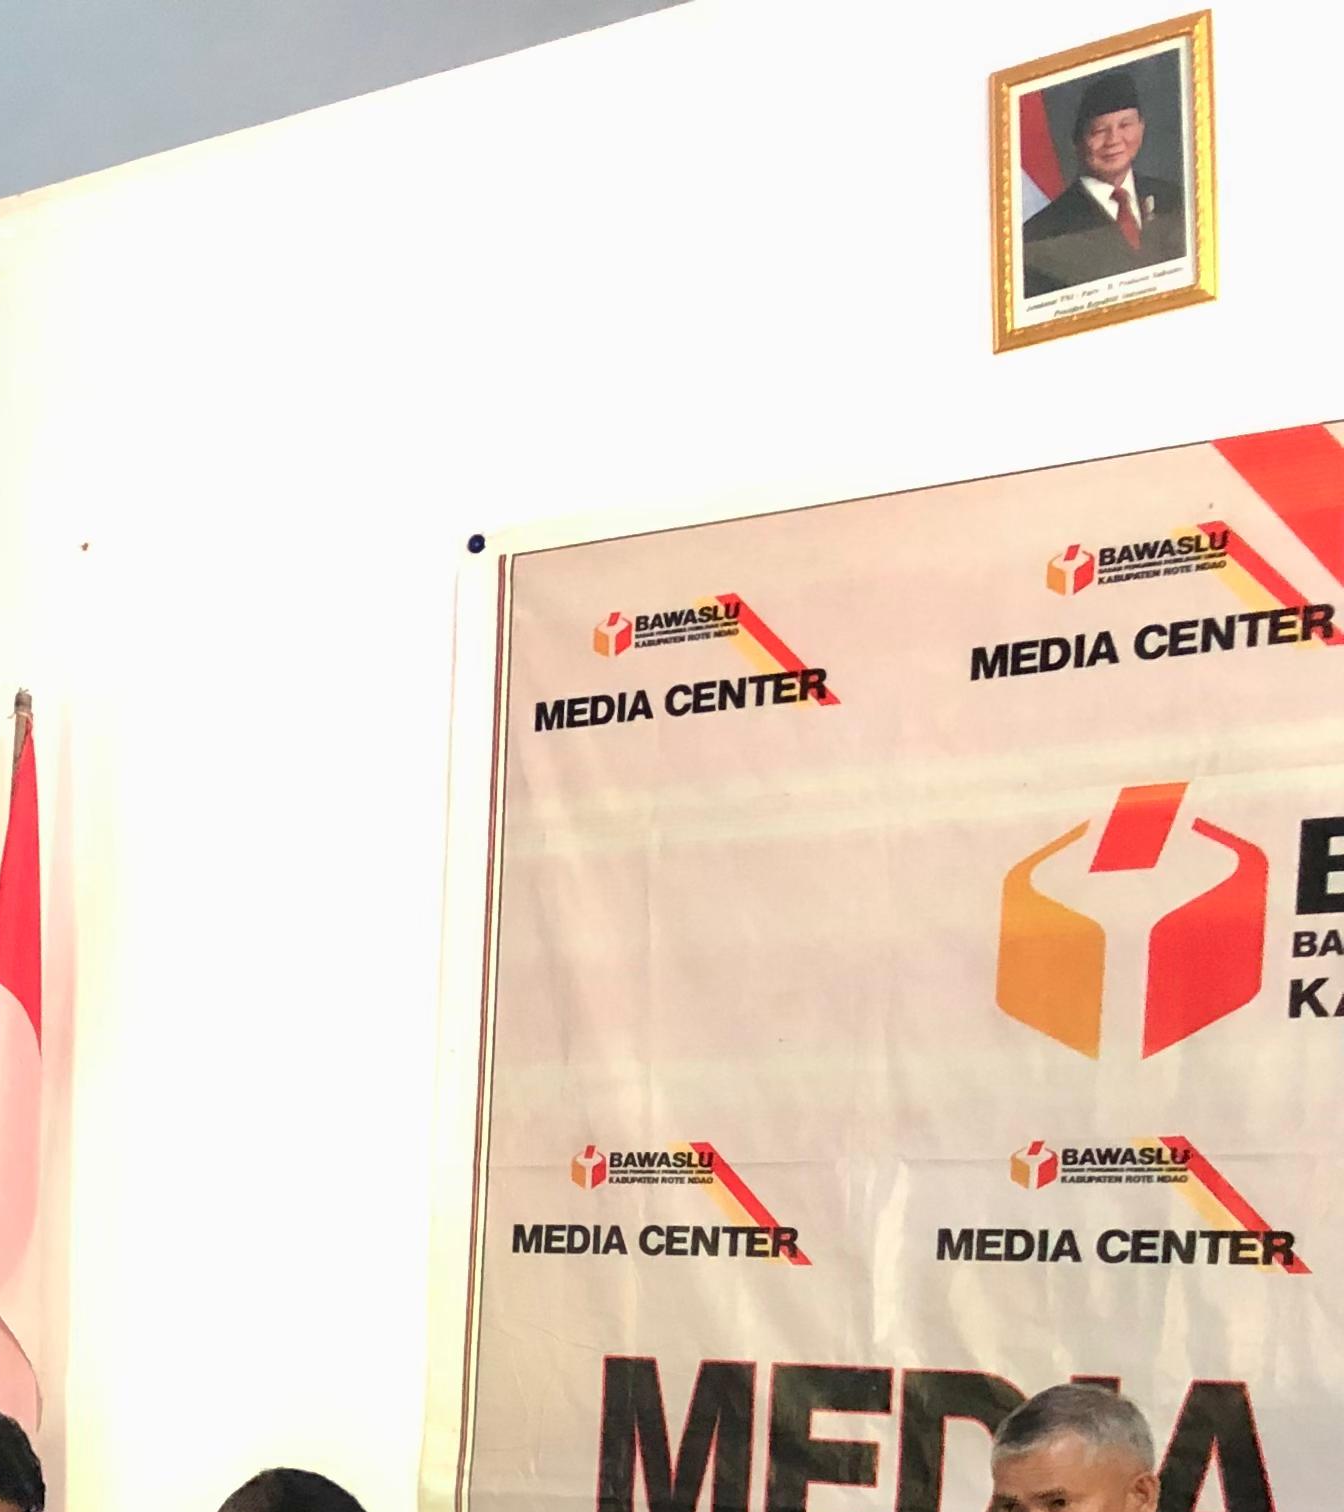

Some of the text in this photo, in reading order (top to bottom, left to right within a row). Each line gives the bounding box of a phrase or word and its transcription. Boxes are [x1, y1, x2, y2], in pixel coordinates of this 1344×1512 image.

[1099, 530, 1228, 566] BAWASLU
[635, 602, 740, 632] BAWASLU
[970, 603, 1335, 681] MEDIA CENTER
[534, 668, 827, 732] MEDIA CENTER
[609, 1152, 714, 1168] BAWASLU
[1062, 1147, 1191, 1165] BAWASLU
[512, 1224, 799, 1258] MEDIA CENTER
[936, 1228, 1295, 1266] MEDIA CENTER
